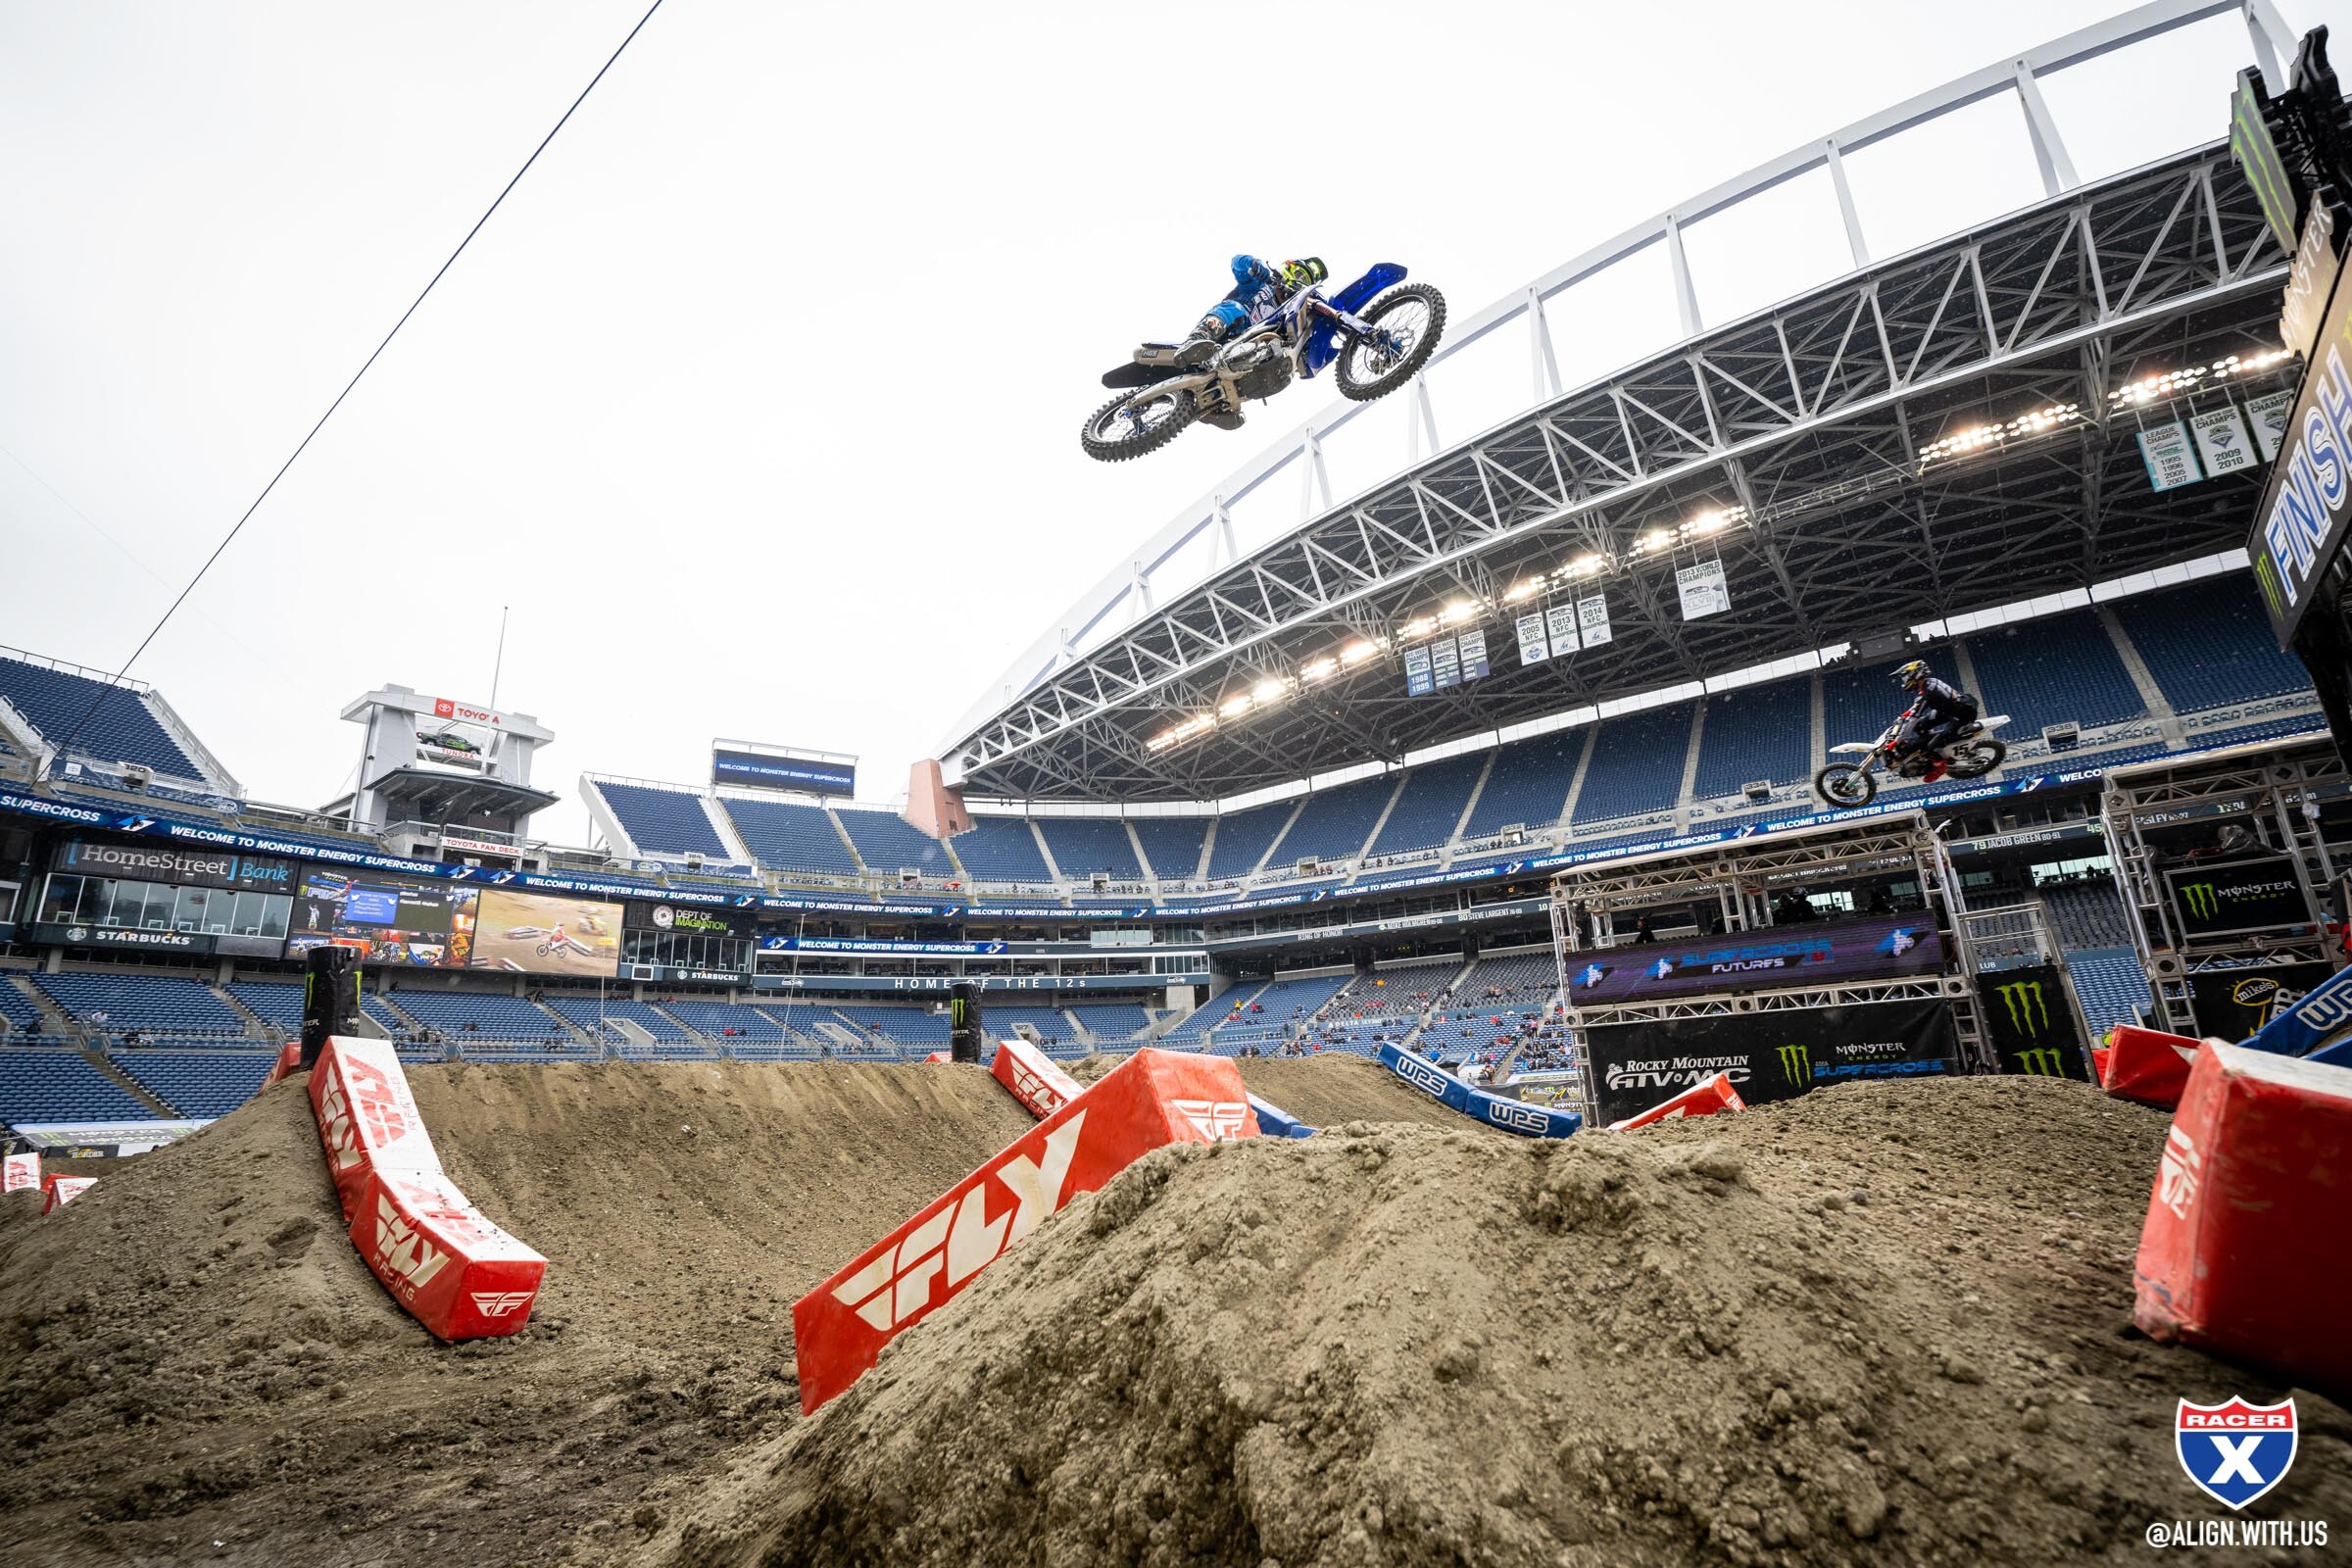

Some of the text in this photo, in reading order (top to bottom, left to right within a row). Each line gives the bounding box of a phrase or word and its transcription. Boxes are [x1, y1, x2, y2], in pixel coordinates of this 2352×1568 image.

[2195, 412, 2237, 429] CHAMPS
[2145, 425, 2176, 438] LEAGUE
[2146, 431, 2180, 445] CHAMPS
[2214, 448, 2241, 462] 2009
[2217, 457, 2244, 470] 2010
[2264, 342, 2352, 608] FINISH
[1677, 568, 1695, 579] 2013
[1678, 567, 1722, 585] CHAMPIONS
[1583, 607, 1603, 619] 2014
[1587, 614, 1601, 624] NFC
[1551, 615, 1572, 628] 2013
[1555, 624, 1569, 633] NFC
[1521, 624, 1541, 636] 2005
[1525, 632, 1539, 641] NFC
[458, 708, 500, 724] TOYOA
[441, 748, 475, 760] TUNDRA
[718, 762, 750, 772] WELCOME
[760, 767, 790, 776] MONSTER
[813, 773, 852, 783] SUPERCROSS
[2059, 768, 2102, 783] WELCO
[0, 794, 101, 822] SUPERCROSS
[1767, 785, 2001, 832] WELCOME TO MONSTER ENERGY SUPERCROSS
[2086, 823, 2103, 834] 45
[171, 825, 437, 873] WELCOME TO MONSTER ENERGY SUPERCROSS
[446, 838, 520, 856] TOYOTA FAN DECK
[1532, 832, 1722, 868] WELCOME TO MONSTER ENERGY SUPERCROSS
[1971, 840, 1986, 851] 79
[1986, 837, 2013, 850] JACOB
[2013, 834, 2041, 846] GREEN
[81, 843, 289, 881] HomeStreet Bank
[525, 876, 725, 903] WELCOME TO MONSTER ENERGY SUPERCROSS
[1334, 867, 1495, 897] WELCOME TO MONSTER ENERGY SUPERCROSS
[763, 899, 804, 908] WELCOME
[815, 902, 854, 911] MONSTER
[884, 906, 934, 914] SUPERCROSS
[1014, 908, 1050, 917] MONSTER
[1155, 907, 1190, 916] WELCOME
[1200, 904, 1232, 914] MONSTER
[1232, 901, 1259, 910] ENERGY
[1258, 895, 1301, 906] SUPERCROSS
[1538, 903, 1548, 912] 10
[675, 908, 700, 920] DEPT
[700, 910, 713, 921] OF
[1468, 910, 1485, 921] STEVE
[1485, 907, 1510, 918] LARGENT
[674, 917, 728, 931] IMAGINATION
[96, 931, 190, 946] STARBUCKS
[1298, 932, 1313, 942] RING
[1322, 928, 1344, 939] HONOR
[798, 940, 976, 953] WELCOME TO MONSTER ENERGY SUPERCROSS
[1680, 938, 1832, 967] SUPERCROSS
[1711, 956, 1786, 974] FUTURES
[691, 971, 739, 981] STARBUCKS
[895, 979, 951, 989] HOME
[1004, 978, 1040, 989] THE
[1054, 978, 1086, 989] 12s
[2236, 981, 2275, 1002] mike's
[1835, 1042, 1907, 1055] MONSTER
[1625, 1054, 1749, 1073] ROCKY MOUNTAIN
[1813, 1059, 1945, 1078] SUPERCROSS
[1395, 1054, 1449, 1098] WPS
[1490, 1102, 1550, 1135] WPS
[832, 1108, 1088, 1332] FLY
